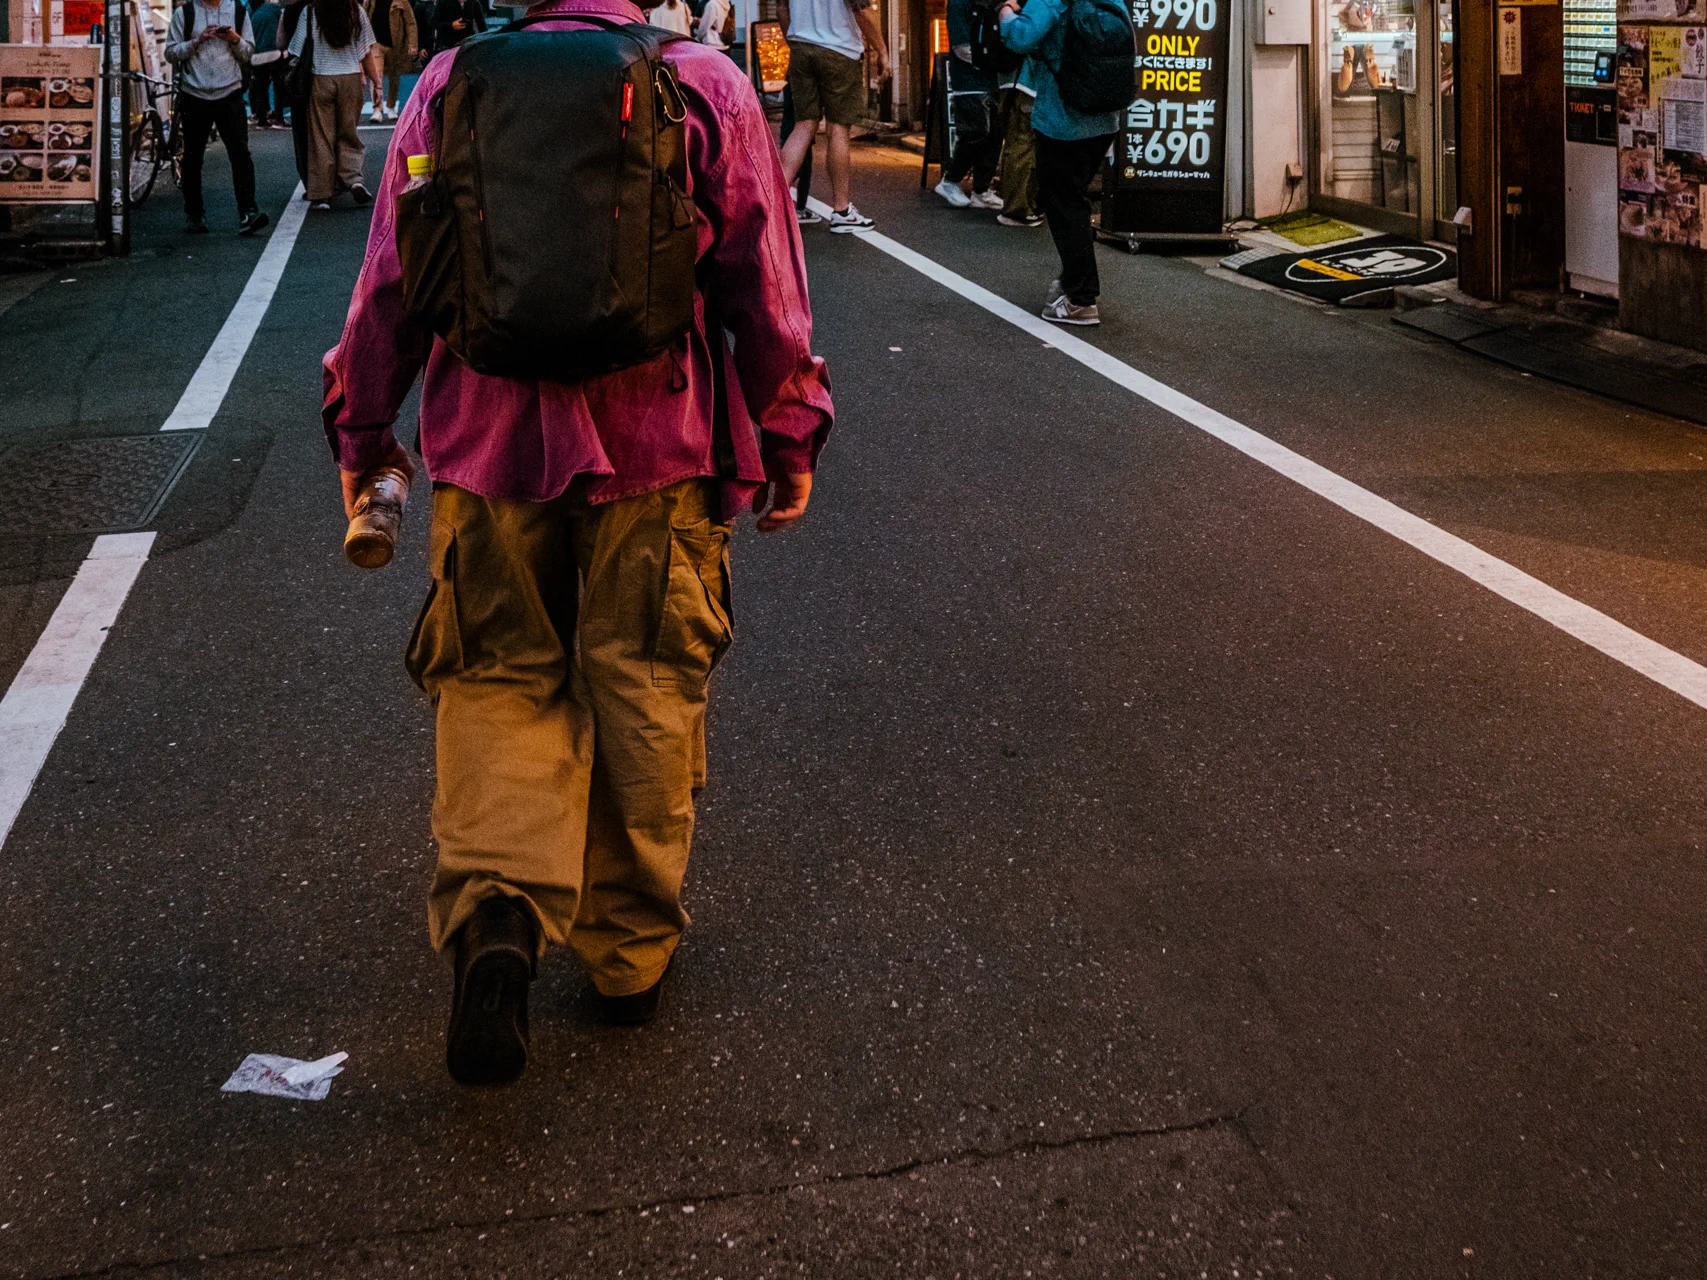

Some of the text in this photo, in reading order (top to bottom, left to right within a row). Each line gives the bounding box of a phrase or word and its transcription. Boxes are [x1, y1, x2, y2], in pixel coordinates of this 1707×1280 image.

[1146, 34, 1200, 56] ONLY
[1141, 70, 1202, 92] PRICE
[1127, 98, 1216, 130] 合カギ
[1126, 133, 1143, 144] 1本
[1127, 130, 1211, 165] ¥690
